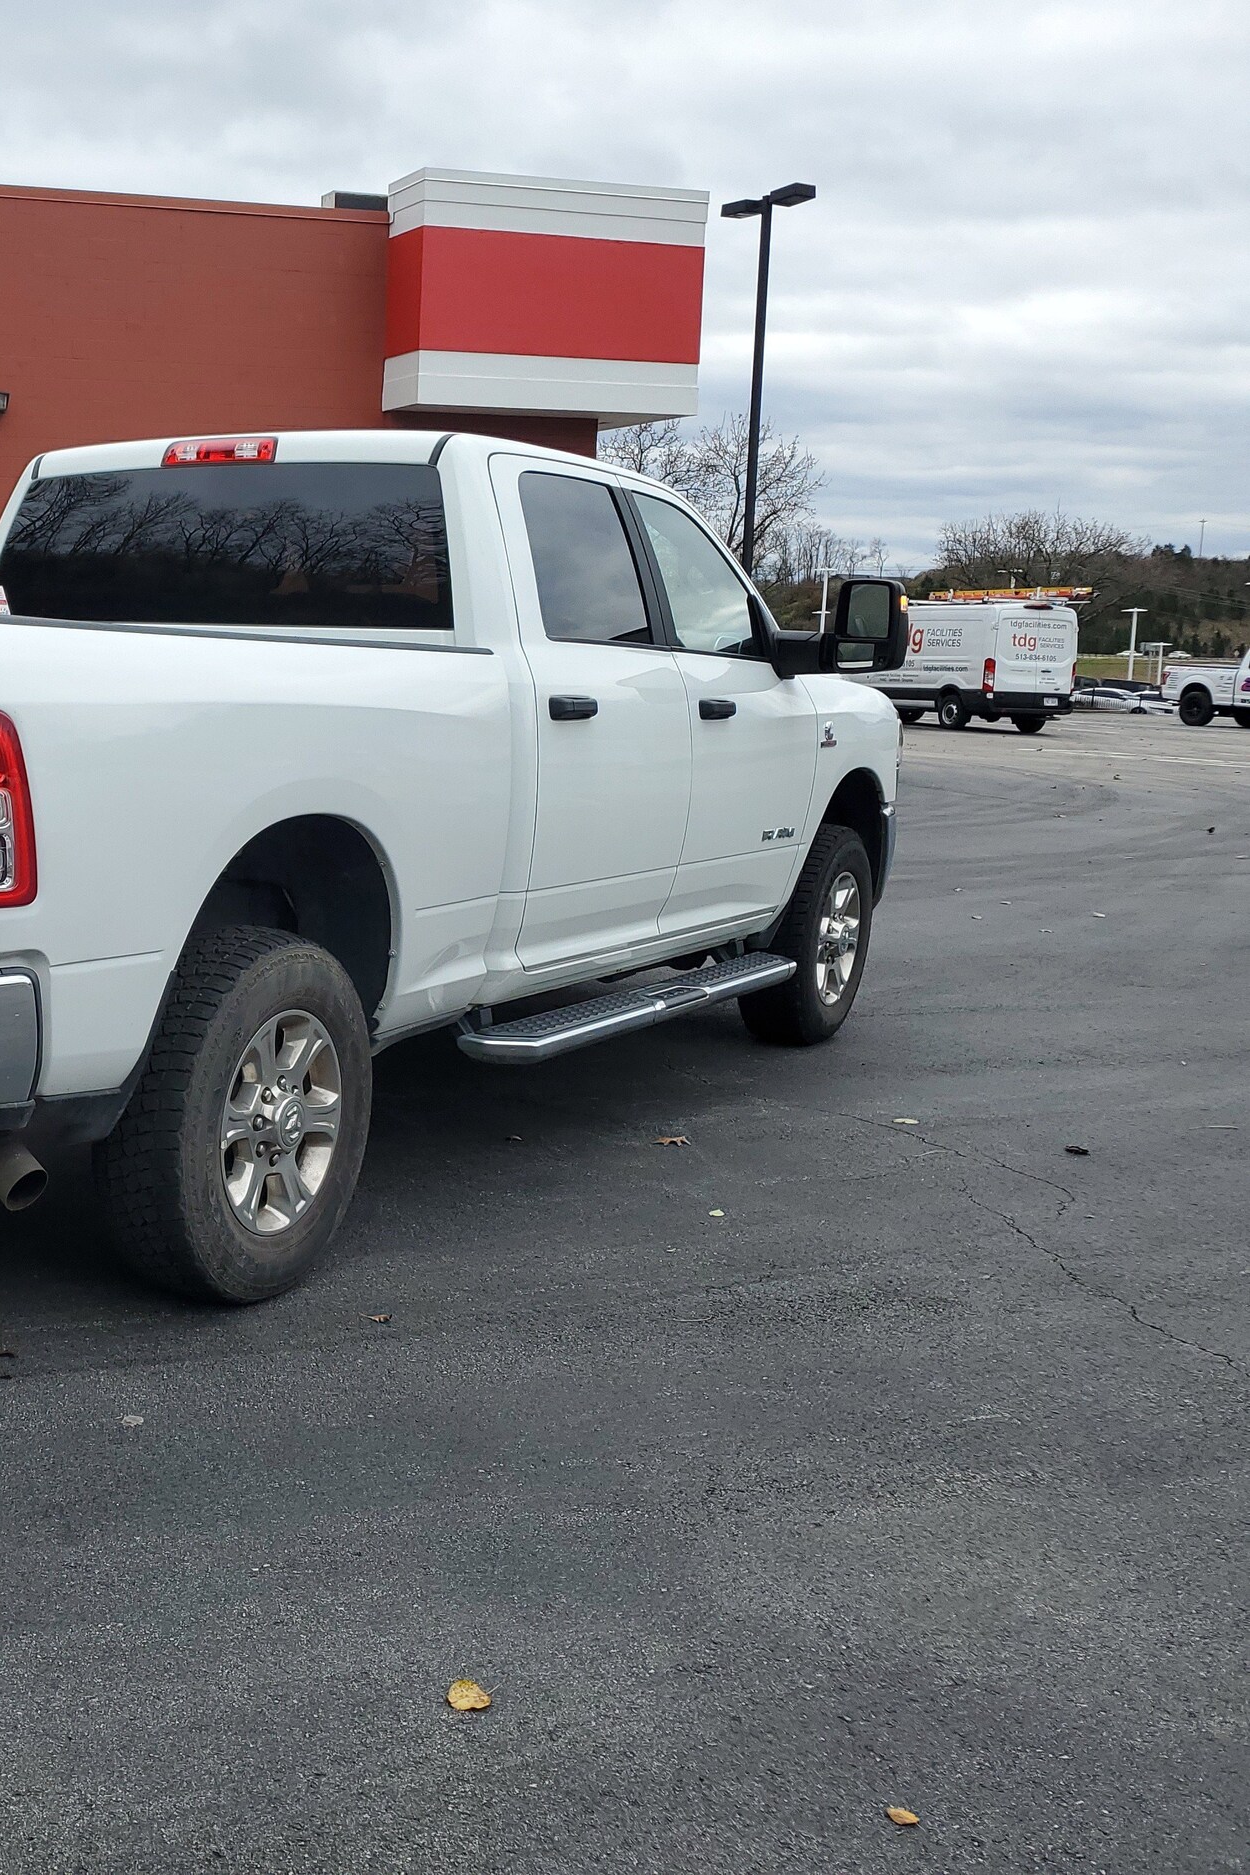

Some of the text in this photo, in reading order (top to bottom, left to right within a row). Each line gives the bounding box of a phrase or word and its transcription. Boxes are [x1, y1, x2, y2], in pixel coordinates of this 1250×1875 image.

[1010, 620, 1067, 630] tdgfacilities.com
[927, 628, 963, 637] FACILITIES
[927, 638, 961, 647] SERVICES
[1012, 633, 1037, 651] tdg
[923, 665, 968, 673] tdgfacilities.com
[761, 827, 795, 842] RAM
